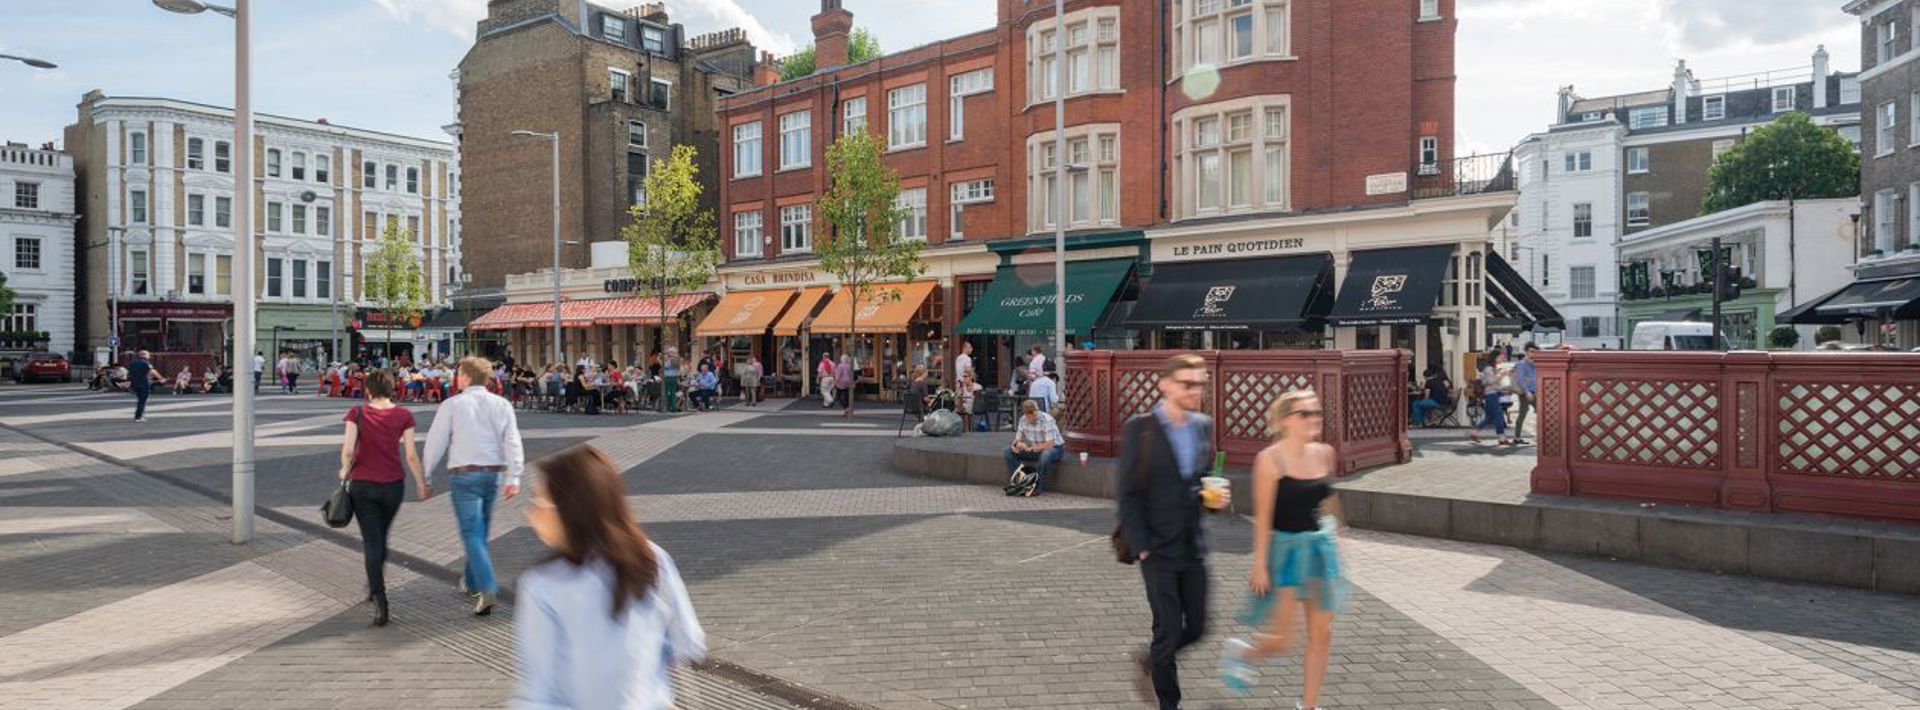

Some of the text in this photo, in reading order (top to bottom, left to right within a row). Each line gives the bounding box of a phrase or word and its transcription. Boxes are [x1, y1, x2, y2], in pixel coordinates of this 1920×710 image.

[1173, 238, 1304, 256] LE PAIN QUOTIDIEN
[744, 271, 815, 285] CASA BRINDISA
[1000, 293, 1085, 307] GREENFIDS
